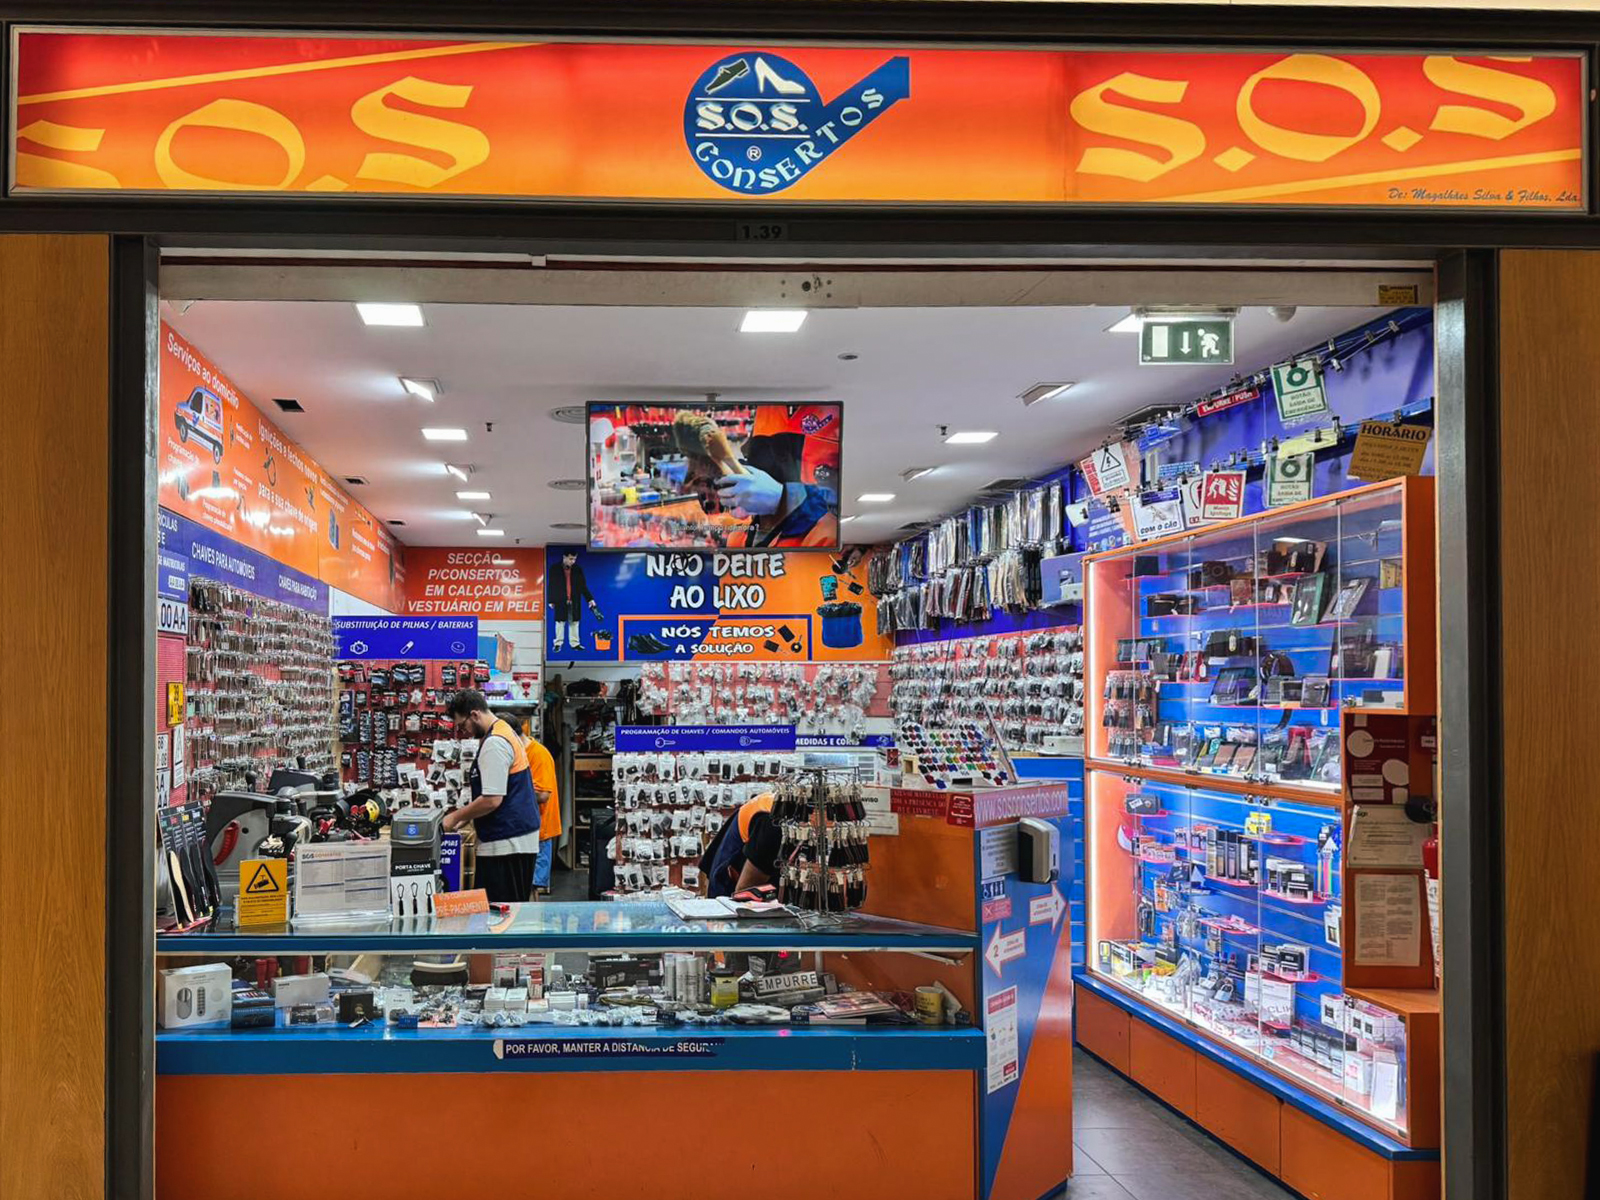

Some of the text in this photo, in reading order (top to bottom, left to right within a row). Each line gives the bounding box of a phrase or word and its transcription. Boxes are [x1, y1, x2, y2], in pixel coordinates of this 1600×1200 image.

[1473, 189, 1501, 200] Silva
[1505, 190, 1514, 201] &
[742, 226, 782, 239] 1.39
[167, 332, 201, 375] Serviços
[202, 367, 211, 384] ao
[191, 541, 215, 566] CHAVES
[447, 551, 501, 567] SECÇÃO
[712, 553, 785, 578] DEITE
[428, 568, 520, 581] P/CONSERTOS
[425, 584, 524, 599] EM CALÇADO E
[669, 584, 766, 609] AO LIXO
[408, 598, 541, 613] VESTUÁRIO EM PELE
[336, 619, 389, 631] SUBSTITUIÇÃO
[390, 621, 401, 629] DE
[402, 620, 430, 629] PILHAS
[437, 620, 474, 630] BATERIAS
[661, 623, 776, 638] NÓS TEMOS
[675, 641, 754, 656] A SOLUÇÃO
[620, 728, 670, 736] PROGRAMAÇÃO
[749, 727, 790, 735] AUTOMÓVEIS
[829, 738, 836, 746] E
[757, 973, 818, 991] EMPURRE
[505, 1043, 526, 1055] POR
[527, 1043, 560, 1055] FAVOR,
[563, 1042, 601, 1054] MANTER
[603, 1042, 610, 1053] A
